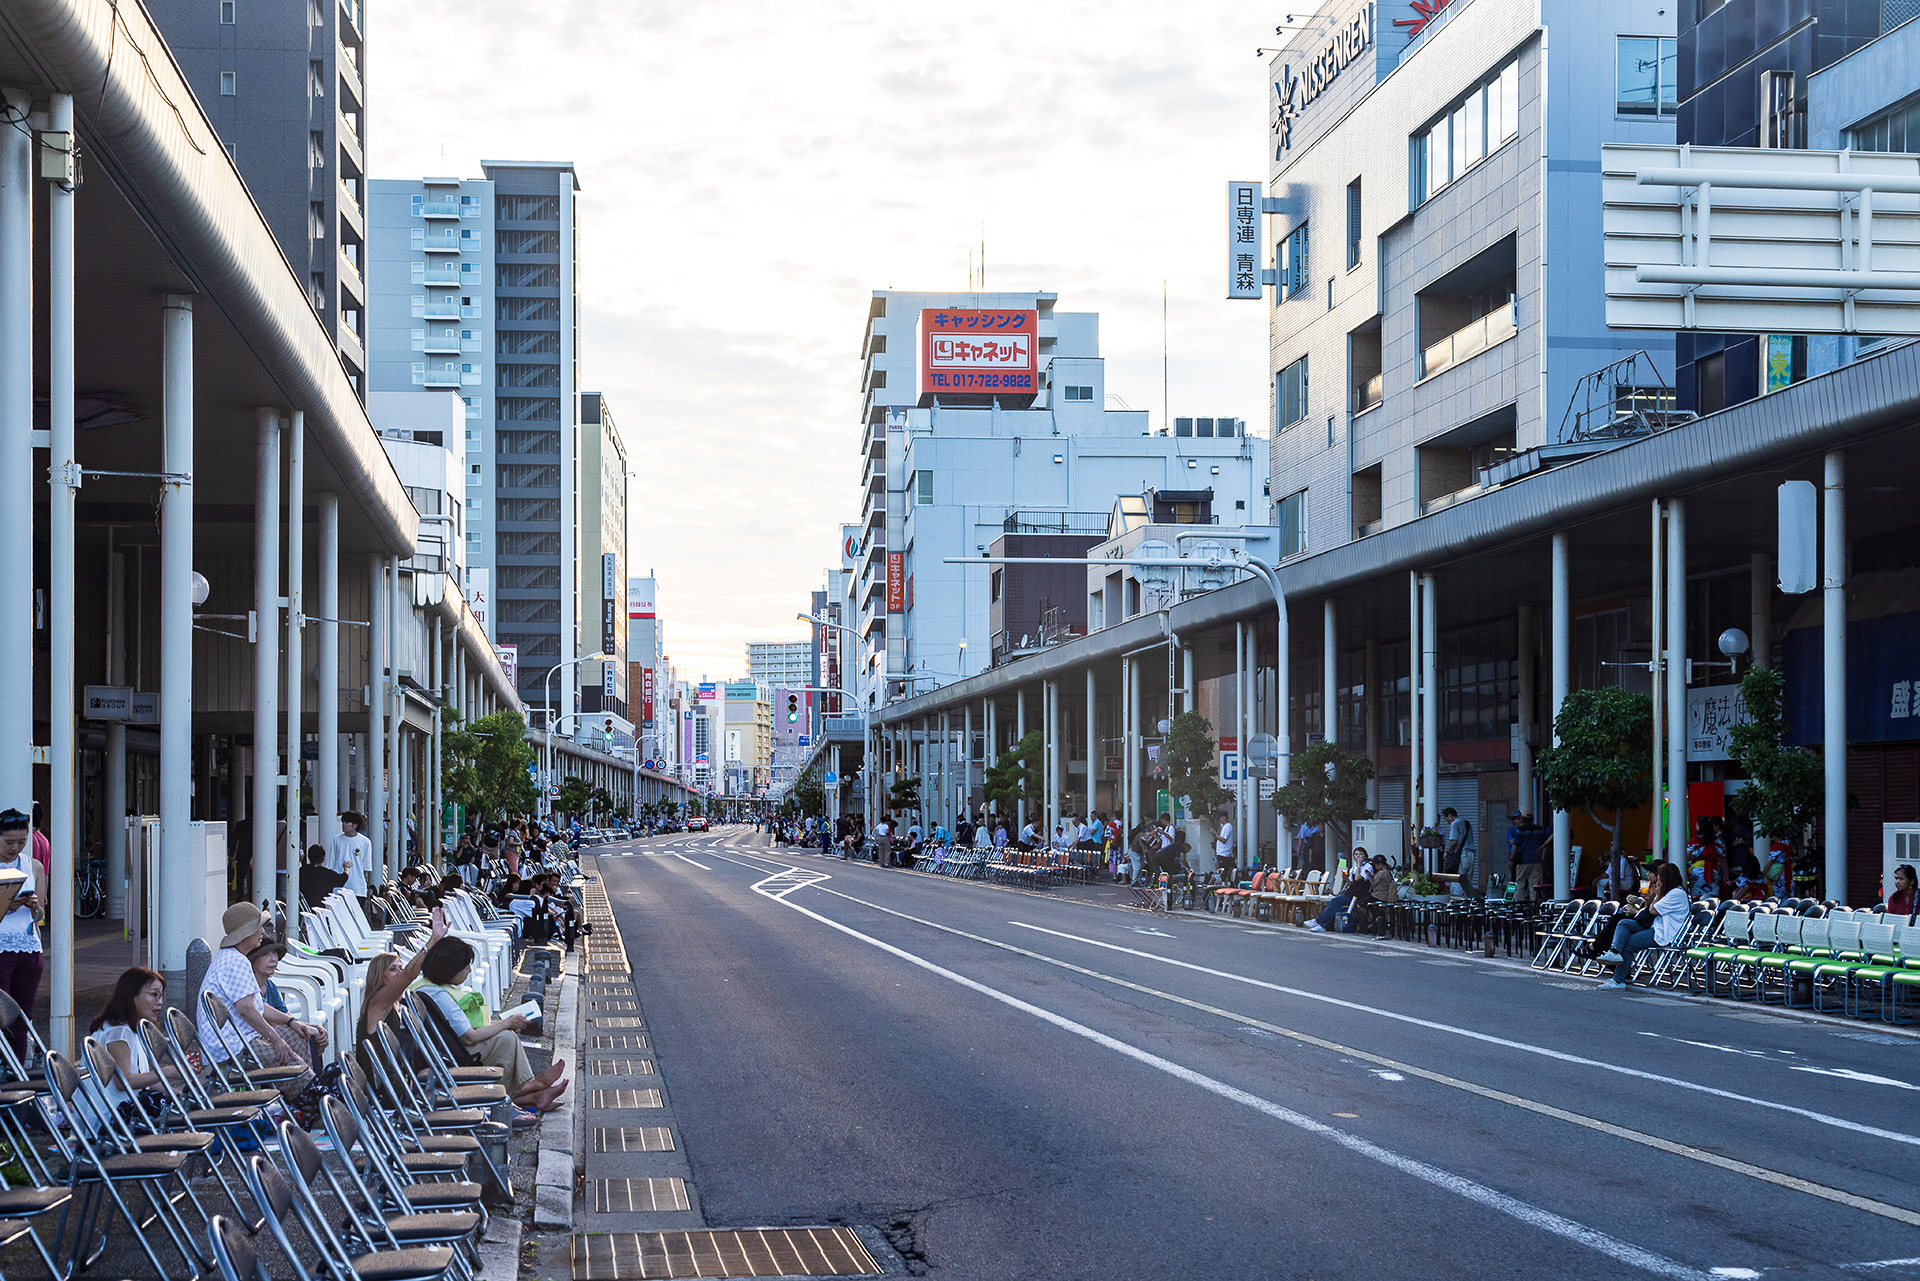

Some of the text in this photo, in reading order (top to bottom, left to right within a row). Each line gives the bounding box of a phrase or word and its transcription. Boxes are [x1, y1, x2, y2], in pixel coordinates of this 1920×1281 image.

[1299, 2, 1374, 111] NISSENREN
[1236, 188, 1254, 290] 日専連 青森
[934, 313, 1027, 328] キャッシング
[955, 341, 1027, 362] キャネット
[930, 374, 950, 386] TEL
[890, 565, 900, 602] キャネット
